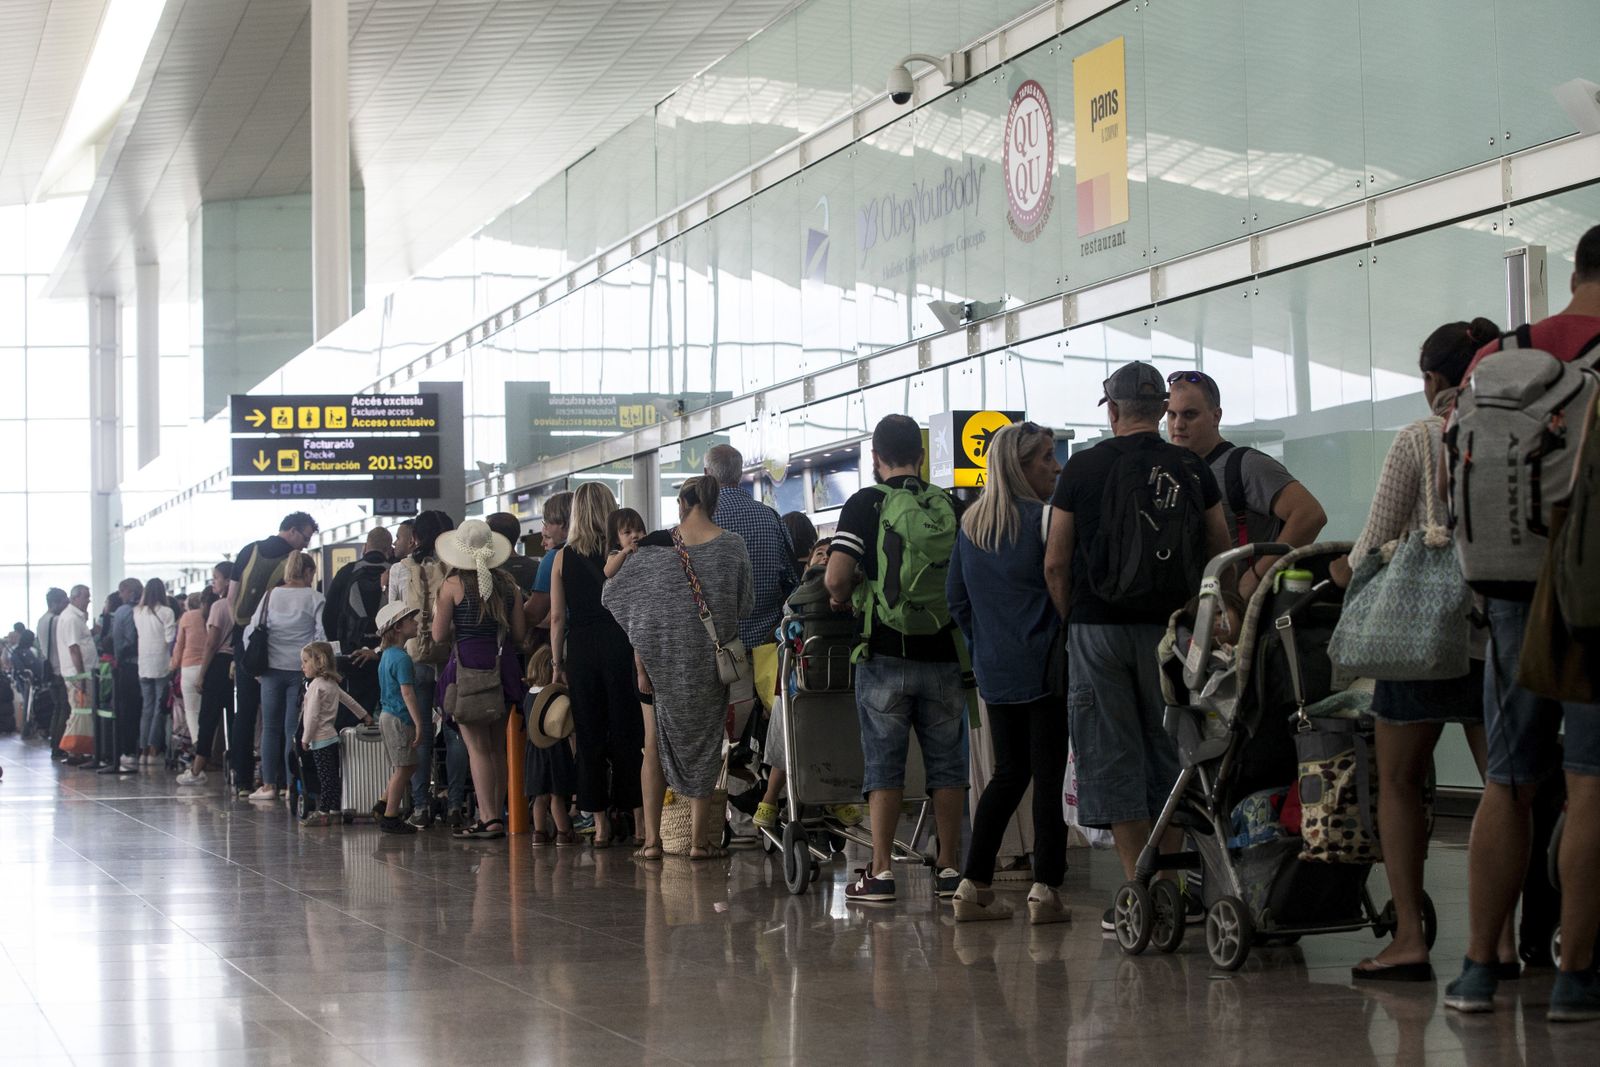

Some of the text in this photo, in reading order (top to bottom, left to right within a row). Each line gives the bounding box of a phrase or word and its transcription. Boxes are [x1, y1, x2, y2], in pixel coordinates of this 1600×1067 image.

[1019, 85, 1033, 100] TAPAS
[1036, 89, 1051, 132] BURGERS
[1091, 89, 1119, 133] pans
[1014, 108, 1040, 158] QU
[1015, 155, 1041, 205] QU
[1081, 230, 1126, 257] restaurant
[351, 396, 423, 406] Accés exclusiu
[351, 407, 386, 416] Exclusive
[352, 417, 435, 427] Acceso exclusivo
[303, 439, 355, 449] Facturació
[304, 451, 335, 459] Check-in
[304, 461, 360, 470] Facturación
[368, 455, 396, 470] 201
[403, 455, 433, 470] 350
[1507, 432, 1521, 546] OAKLEY
